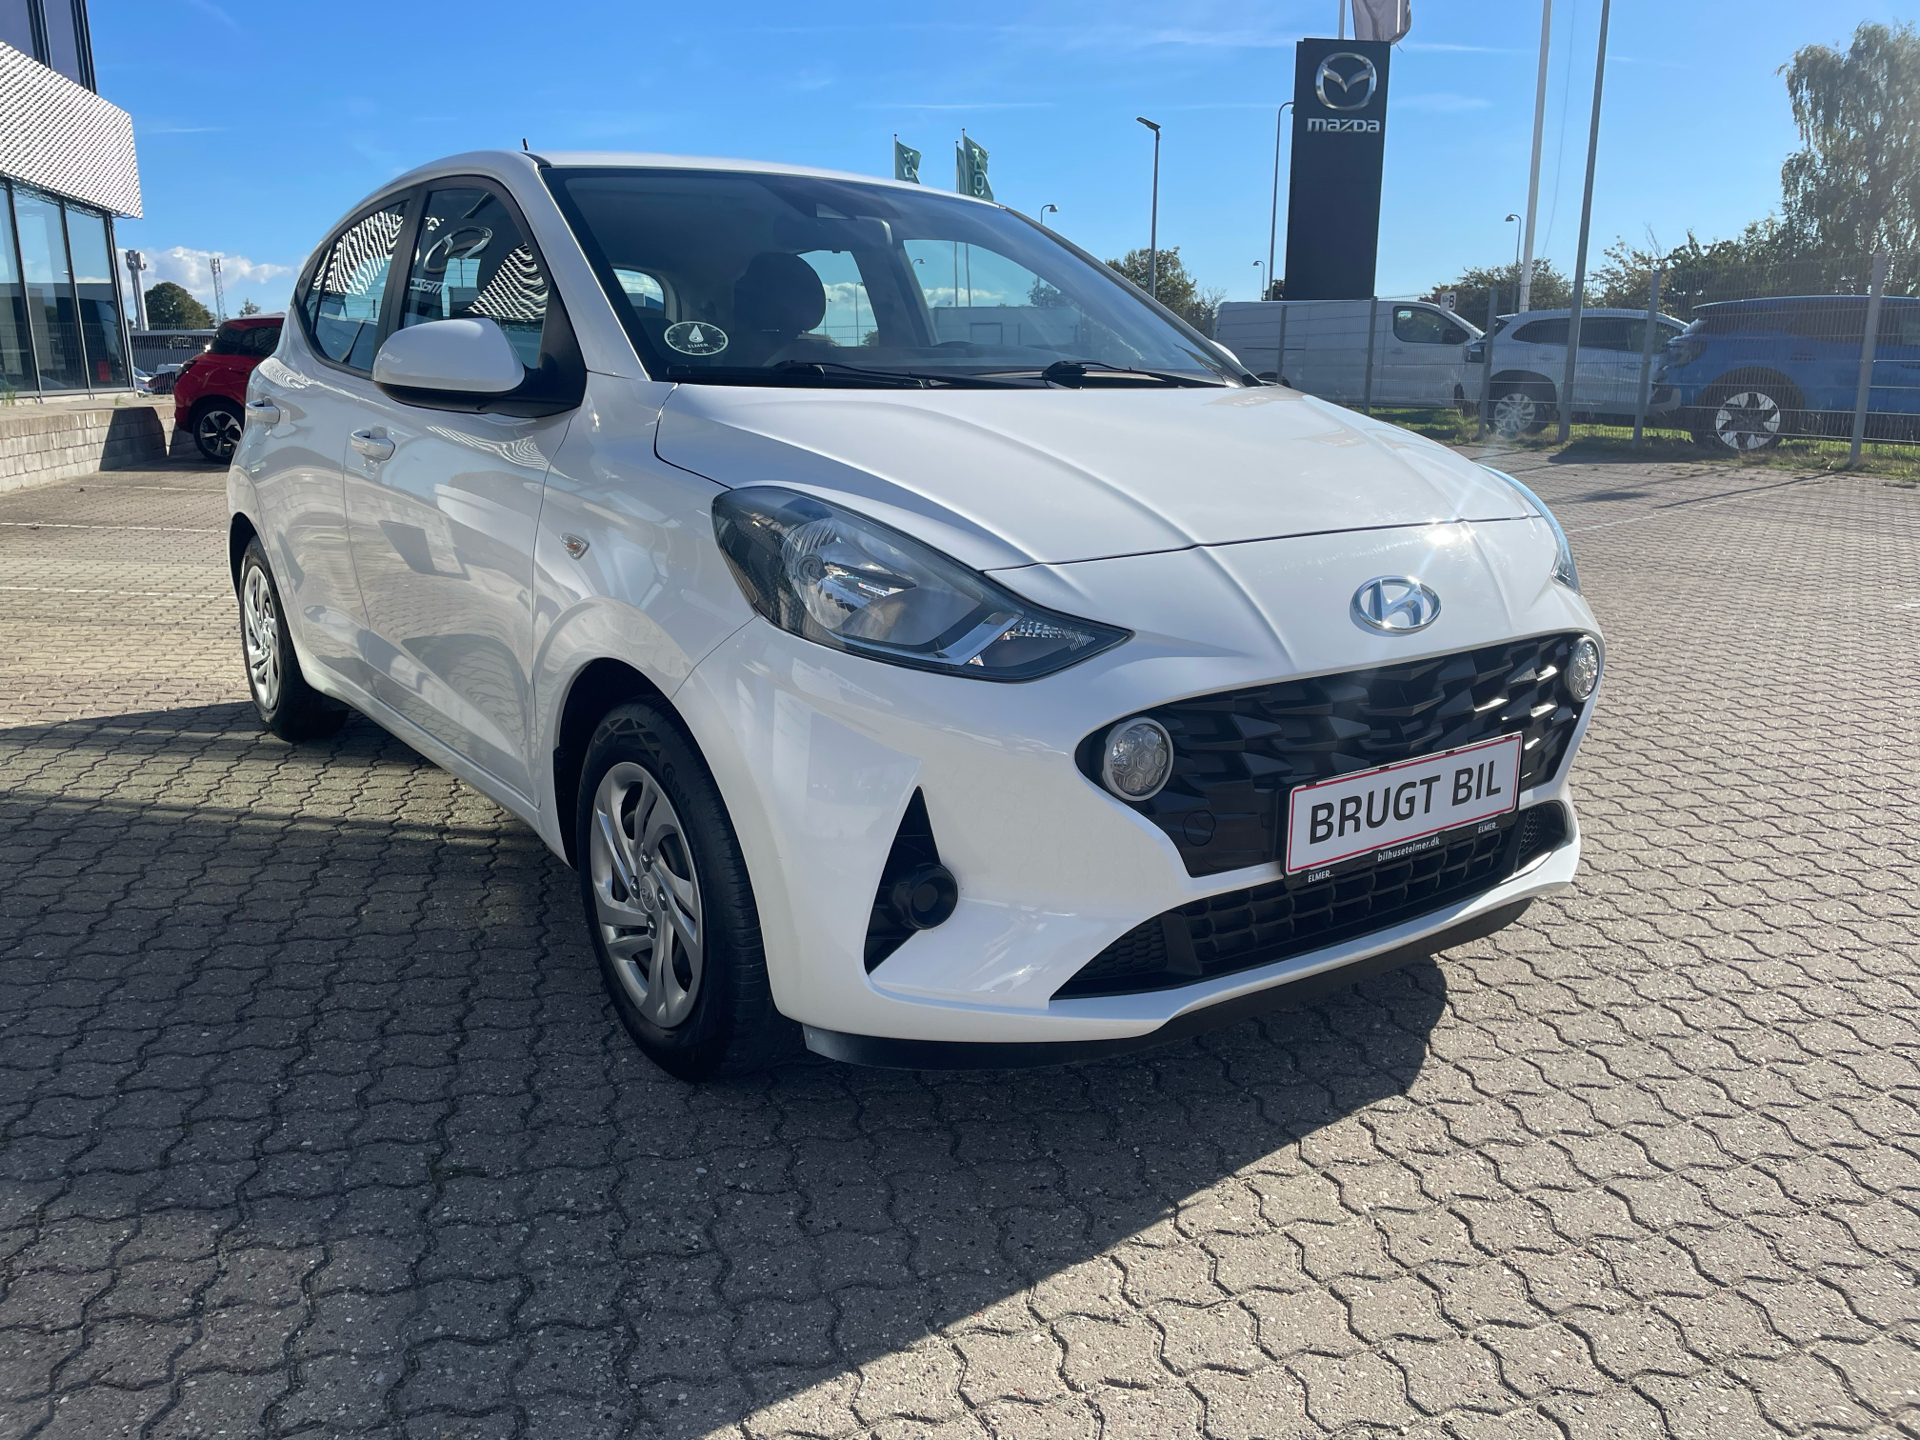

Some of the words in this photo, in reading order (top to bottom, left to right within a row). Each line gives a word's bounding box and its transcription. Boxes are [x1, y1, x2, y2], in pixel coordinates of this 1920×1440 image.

[1310, 775, 1441, 844] BRUGT
[1452, 760, 1501, 806] BIL
[1478, 822, 1496, 833] ELMER
[1377, 837, 1440, 862] bilhusetelmer.dk
[1308, 869, 1331, 883] ELMER
